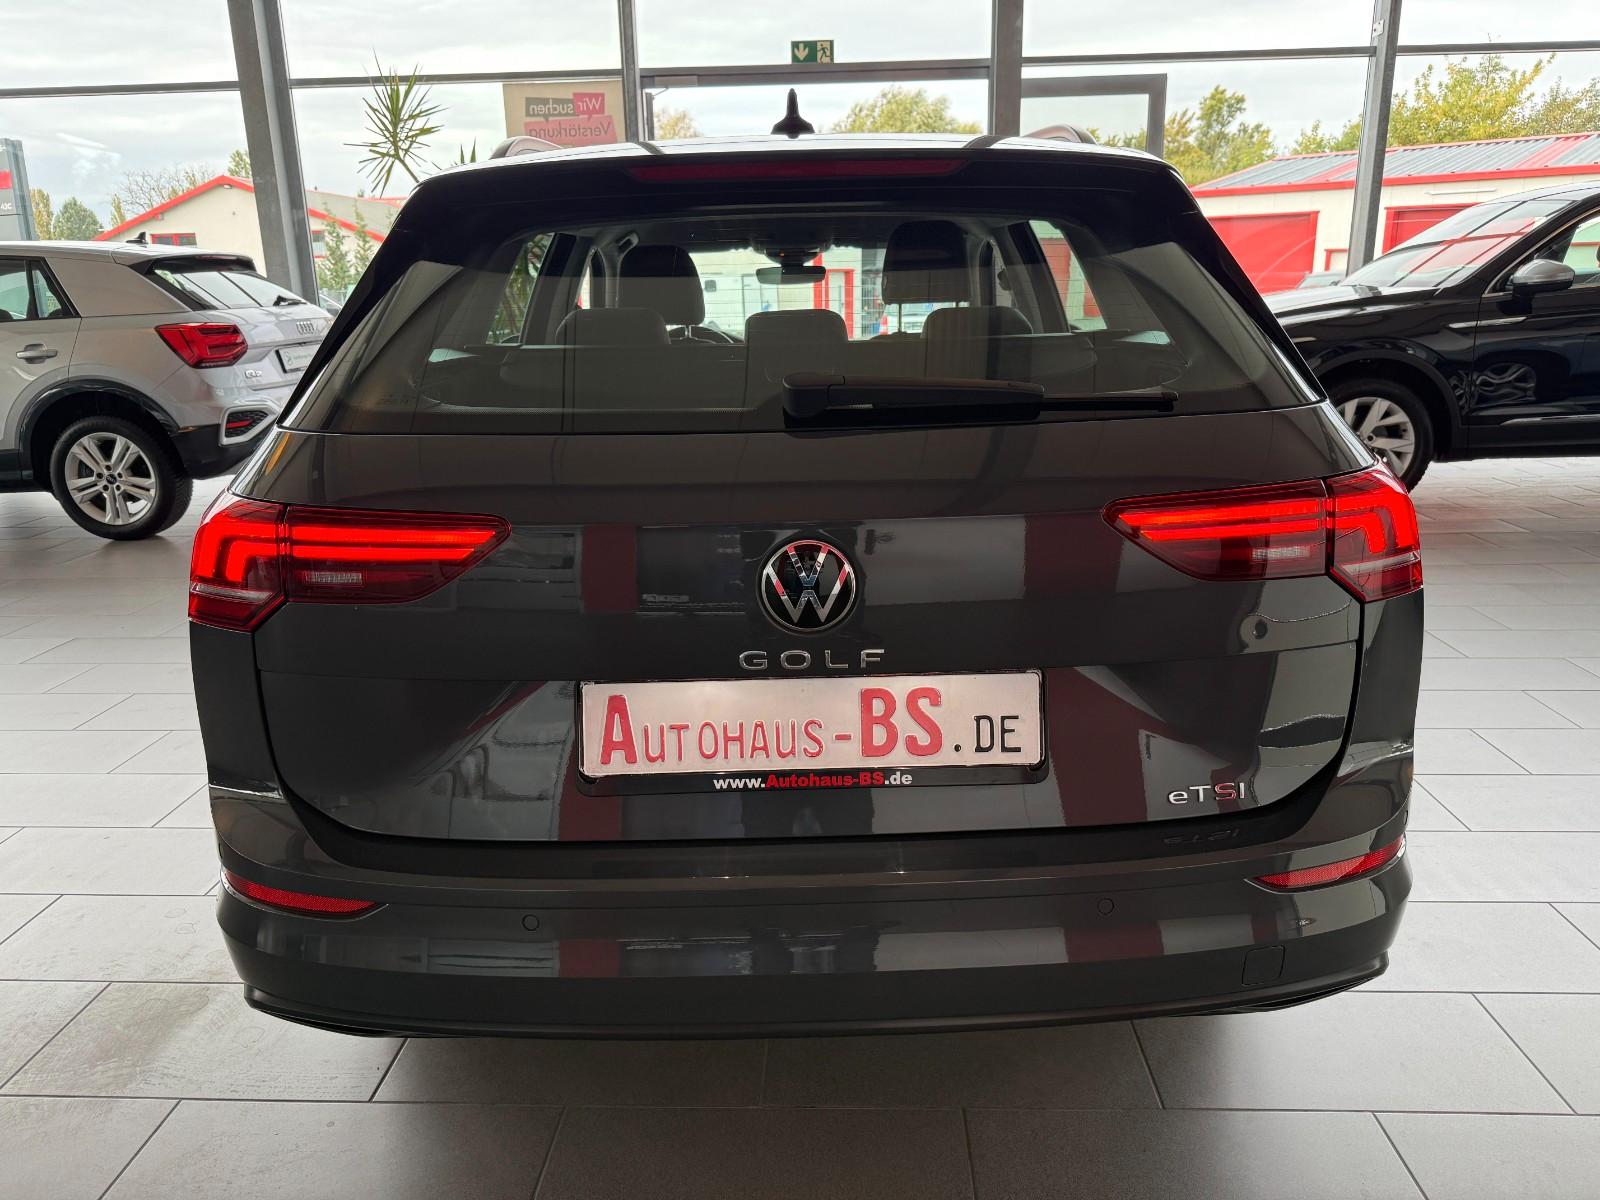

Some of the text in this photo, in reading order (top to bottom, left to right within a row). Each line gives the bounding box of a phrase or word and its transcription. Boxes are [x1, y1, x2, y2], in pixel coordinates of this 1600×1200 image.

[739, 649, 885, 670] GOLF
[713, 771, 913, 789] www.Autohaus-BS.de
[1168, 782, 1245, 804] eTSI
